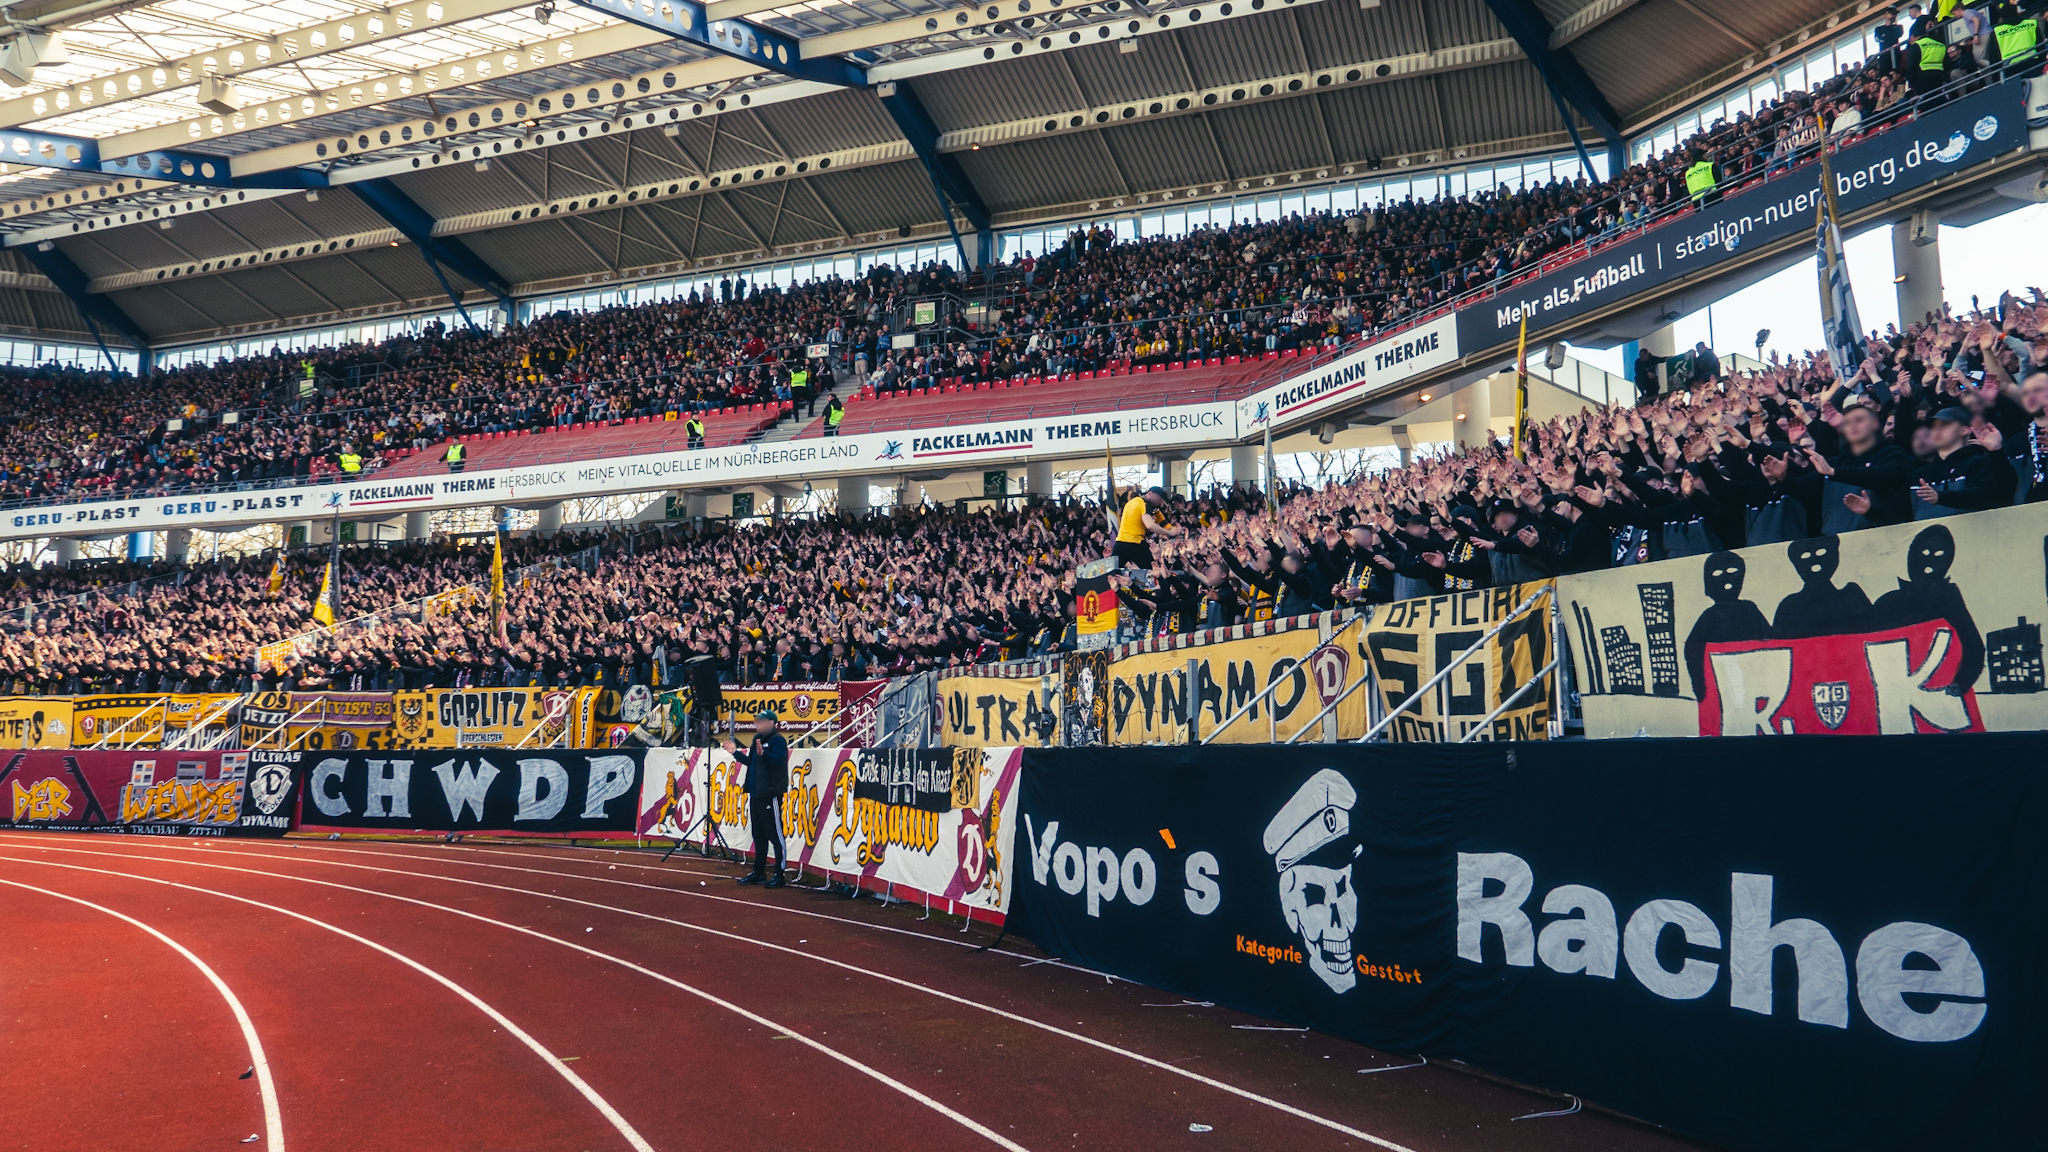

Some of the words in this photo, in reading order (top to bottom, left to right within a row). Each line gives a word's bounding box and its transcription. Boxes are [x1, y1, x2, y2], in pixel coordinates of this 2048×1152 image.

[1496, 298, 1540, 329] Mehr
[1543, 287, 1570, 311] als
[1573, 253, 1646, 295] Fußball
[1674, 139, 1940, 260] stadion-nuerberg.de
[1275, 359, 1366, 410] FACKELMANN
[1374, 330, 1439, 372] THERME
[912, 427, 1034, 451] FACKELMANN
[1046, 420, 1122, 440] THERME
[1128, 411, 1223, 433] HERSBRUCK
[350, 483, 434, 501] FACKELMANN
[443, 477, 496, 494] THERME
[499, 471, 566, 488] HERSBRUCK
[578, 466, 615, 481] MEINE
[618, 459, 702, 477] VITALQUELLE
[705, 457, 720, 470] IM
[723, 447, 817, 468] NÜRNBERGER
[820, 443, 860, 460] LAND
[1112, 656, 1308, 737] DYNAMO
[1865, 627, 1973, 735] K
[243, 709, 289, 725] JETZT
[374, 701, 392, 715] 53
[437, 689, 528, 729] GÖRLITZ
[720, 698, 787, 714] BRIGADE
[816, 699, 839, 715] 53
[251, 750, 302, 763] ULTRAS
[916, 760, 929, 793] den
[930, 760, 951, 793] Knast
[12, 776, 73, 824] DER
[122, 776, 240, 825] WENDE
[130, 824, 180, 835] TRACHAU
[1236, 934, 1303, 965] Kategorie
[1356, 953, 1423, 985] Gestört
[1456, 851, 1988, 1043] Rache
